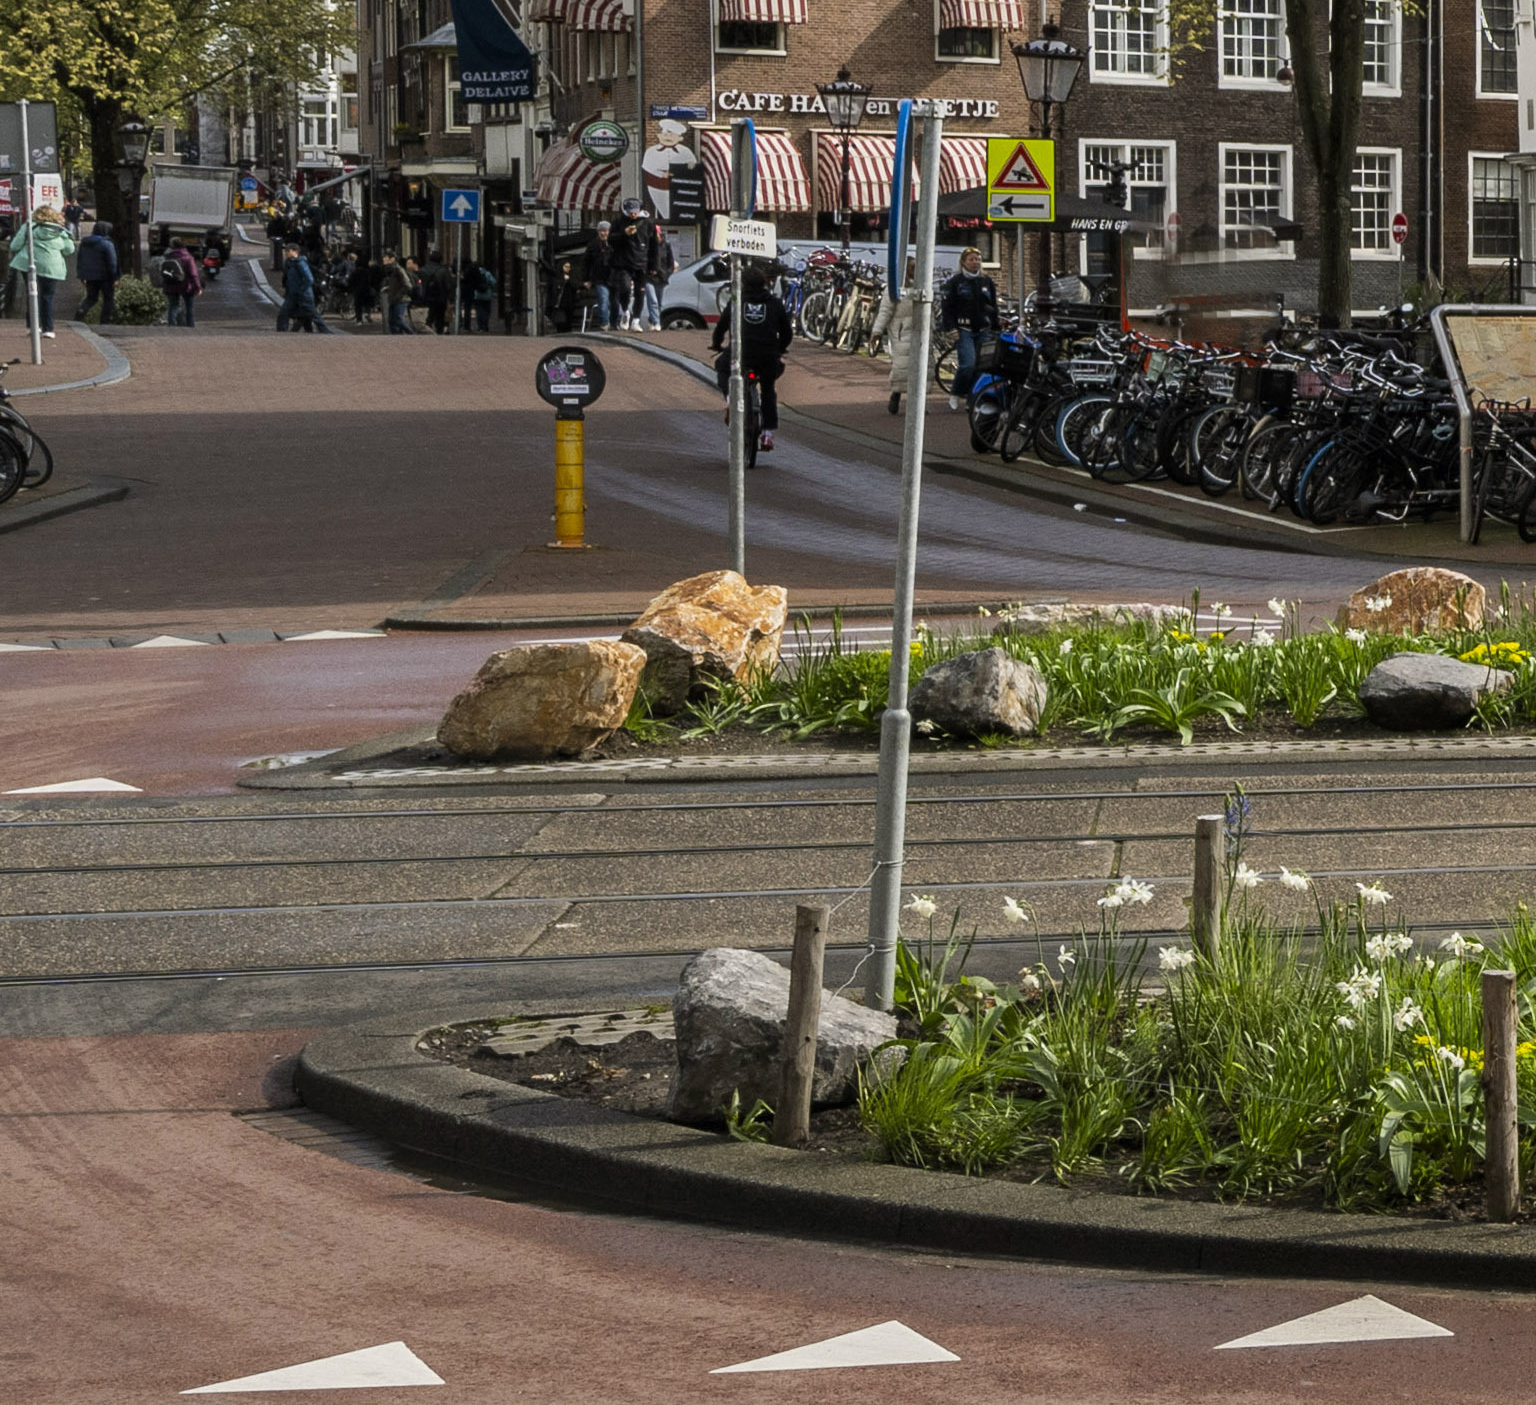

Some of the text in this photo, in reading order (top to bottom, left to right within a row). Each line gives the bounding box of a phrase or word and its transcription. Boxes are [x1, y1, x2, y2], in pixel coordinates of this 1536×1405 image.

[462, 69, 529, 82] GALLERY
[465, 85, 530, 98] DELAIVE
[865, 99, 891, 115] en
[584, 138, 623, 146] Heineken
[727, 220, 765, 236] Snorfiets
[1070, 218, 1097, 230] HANS
[1099, 219, 1113, 231] EN
[727, 237, 766, 251] verboden
